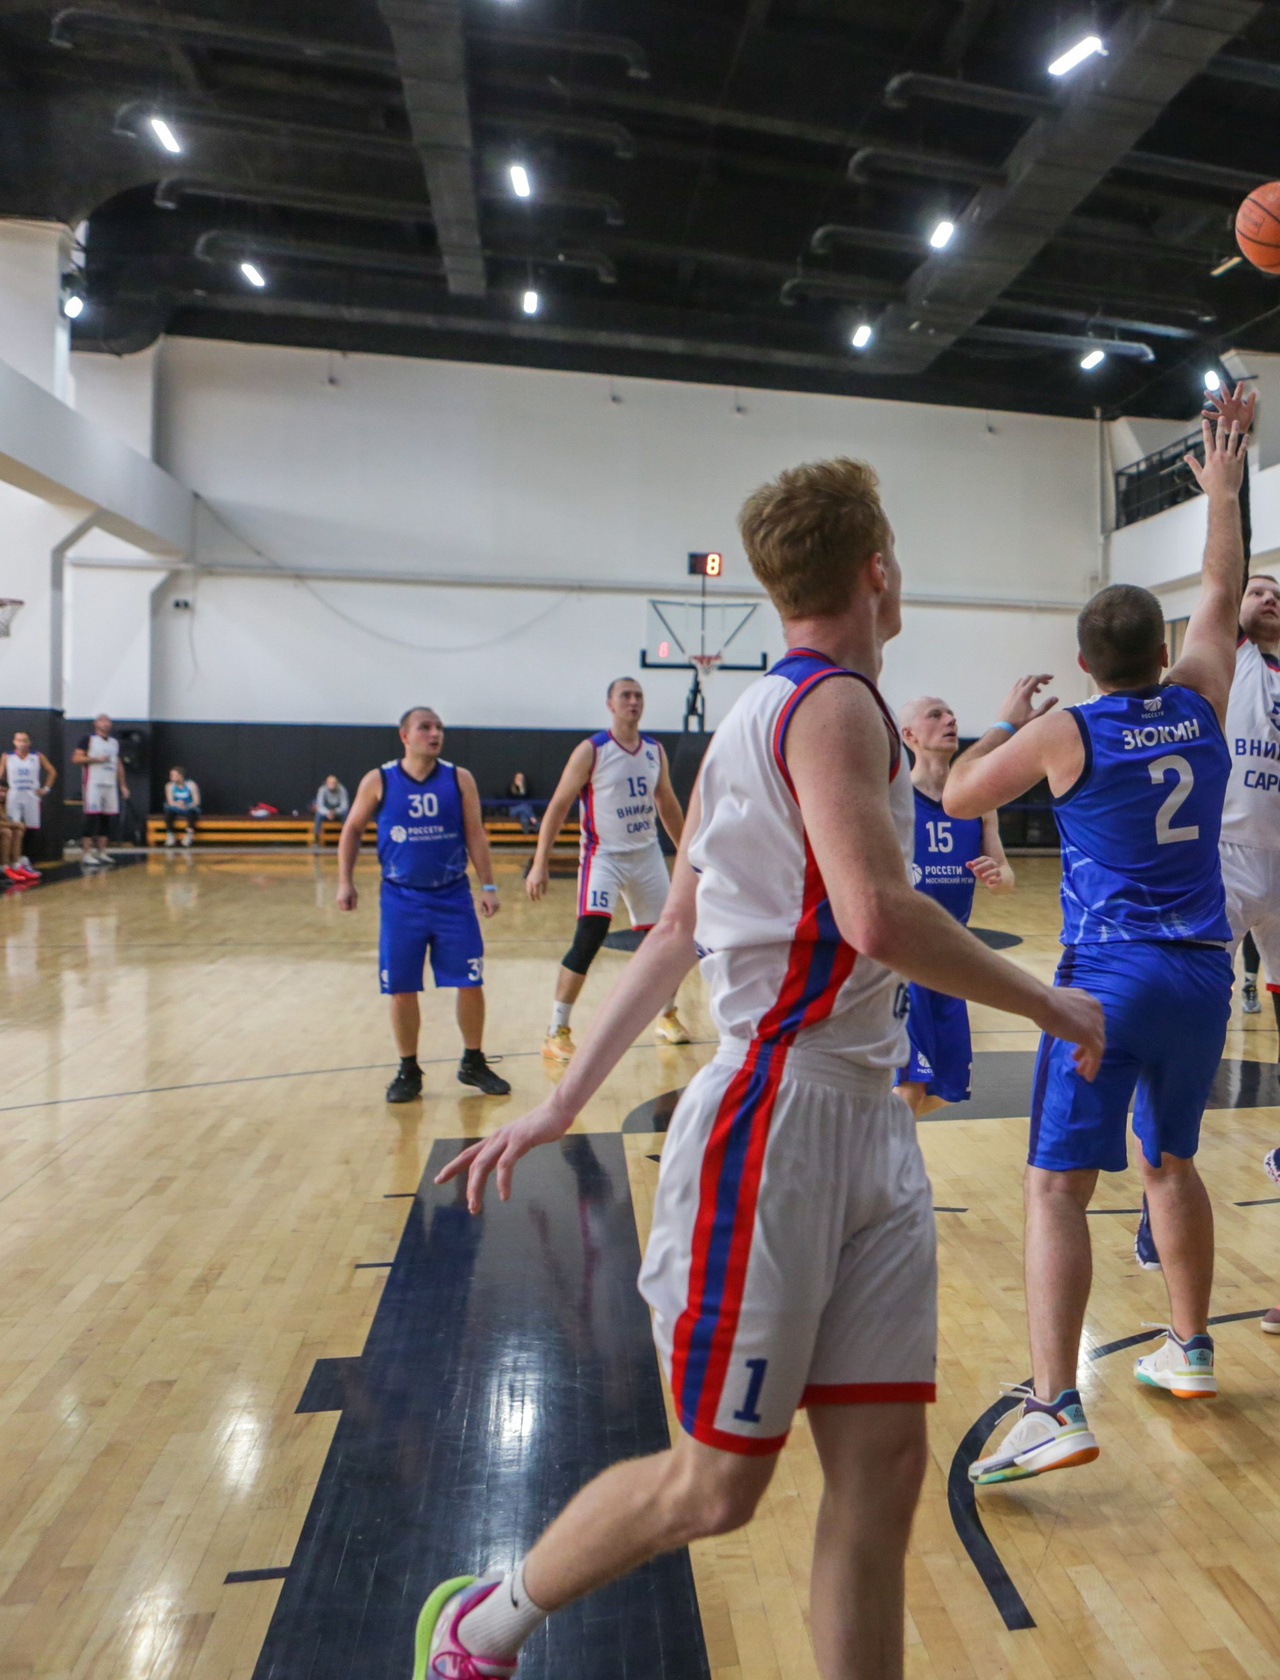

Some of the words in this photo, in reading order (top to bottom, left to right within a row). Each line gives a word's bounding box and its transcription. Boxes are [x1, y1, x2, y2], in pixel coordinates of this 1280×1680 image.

[706, 554, 720, 575] 8
[1122, 718, 1200, 750] ЗЮКИН
[627, 776, 648, 798] 15
[1147, 754, 1200, 845] 2
[407, 792, 439, 818] 30
[925, 821, 954, 853] 15
[925, 865, 963, 875] РОССЕТИ
[591, 890, 609, 908] 15
[733, 1358, 768, 1424] 1
